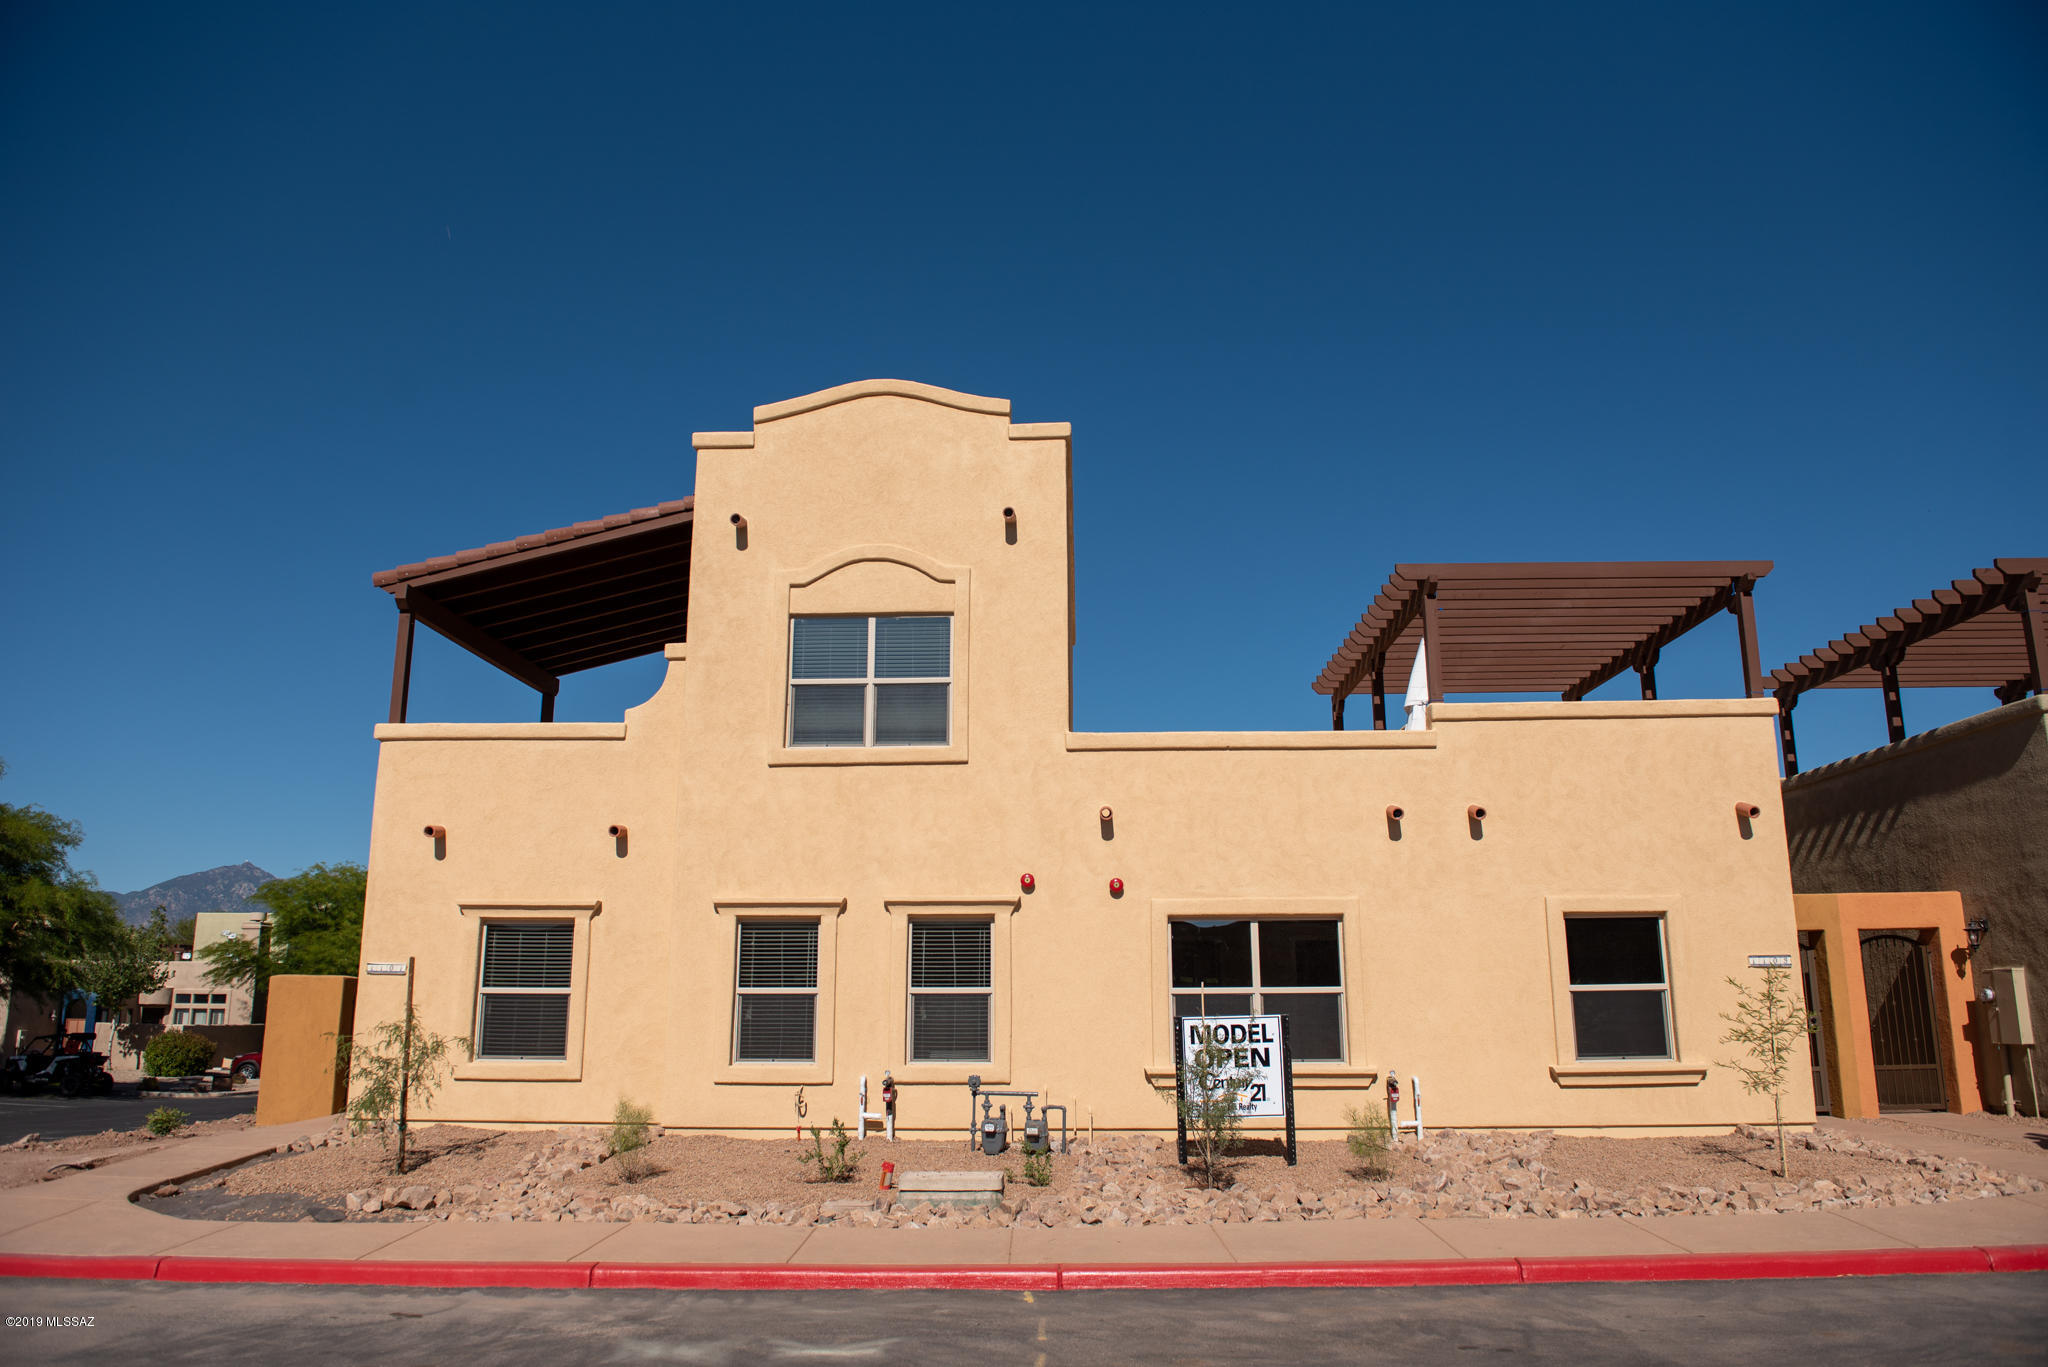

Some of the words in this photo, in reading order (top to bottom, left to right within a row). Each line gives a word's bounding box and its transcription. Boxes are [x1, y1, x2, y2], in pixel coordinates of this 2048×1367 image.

[1190, 1023, 1273, 1045] MODEL
[1195, 1047, 1271, 1068] OPEN
[1199, 1072, 1253, 1091] Ceny
[1250, 1083, 1266, 1102] 21
[1238, 1103, 1258, 1112] Realty
